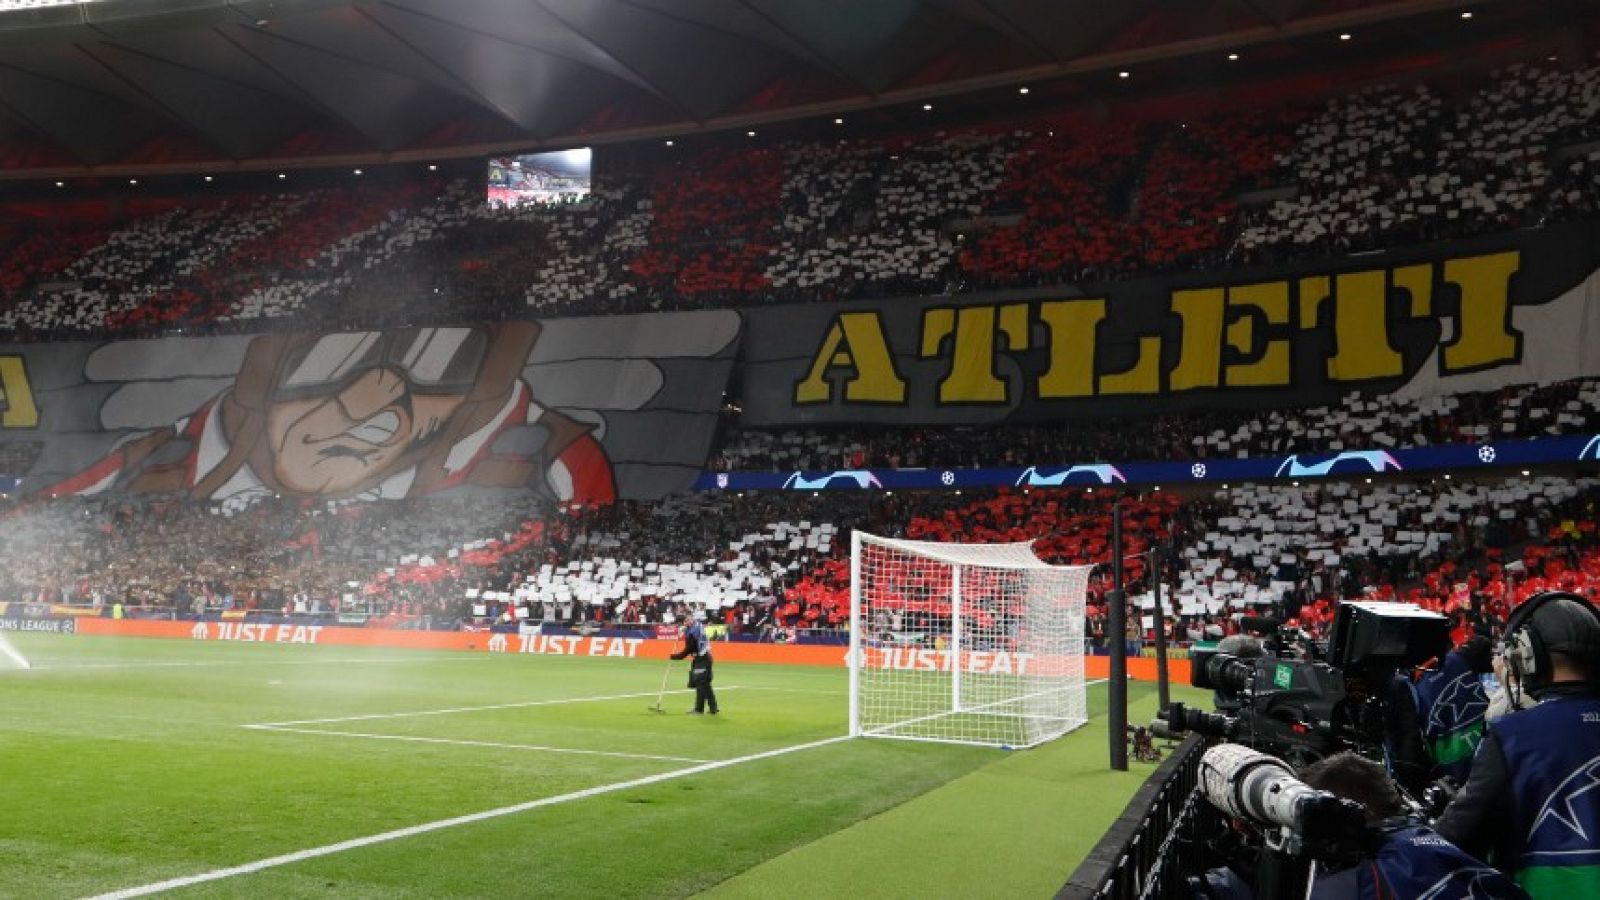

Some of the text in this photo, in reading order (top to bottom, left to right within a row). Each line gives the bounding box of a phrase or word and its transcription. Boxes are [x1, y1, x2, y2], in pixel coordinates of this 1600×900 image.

[796, 250, 1520, 403] ATLETI
[21, 619, 60, 632] LEAGUE
[218, 622, 322, 643] JUST EAT
[519, 633, 643, 657] JUST EAT
[881, 648, 1033, 674] JUST EAT
